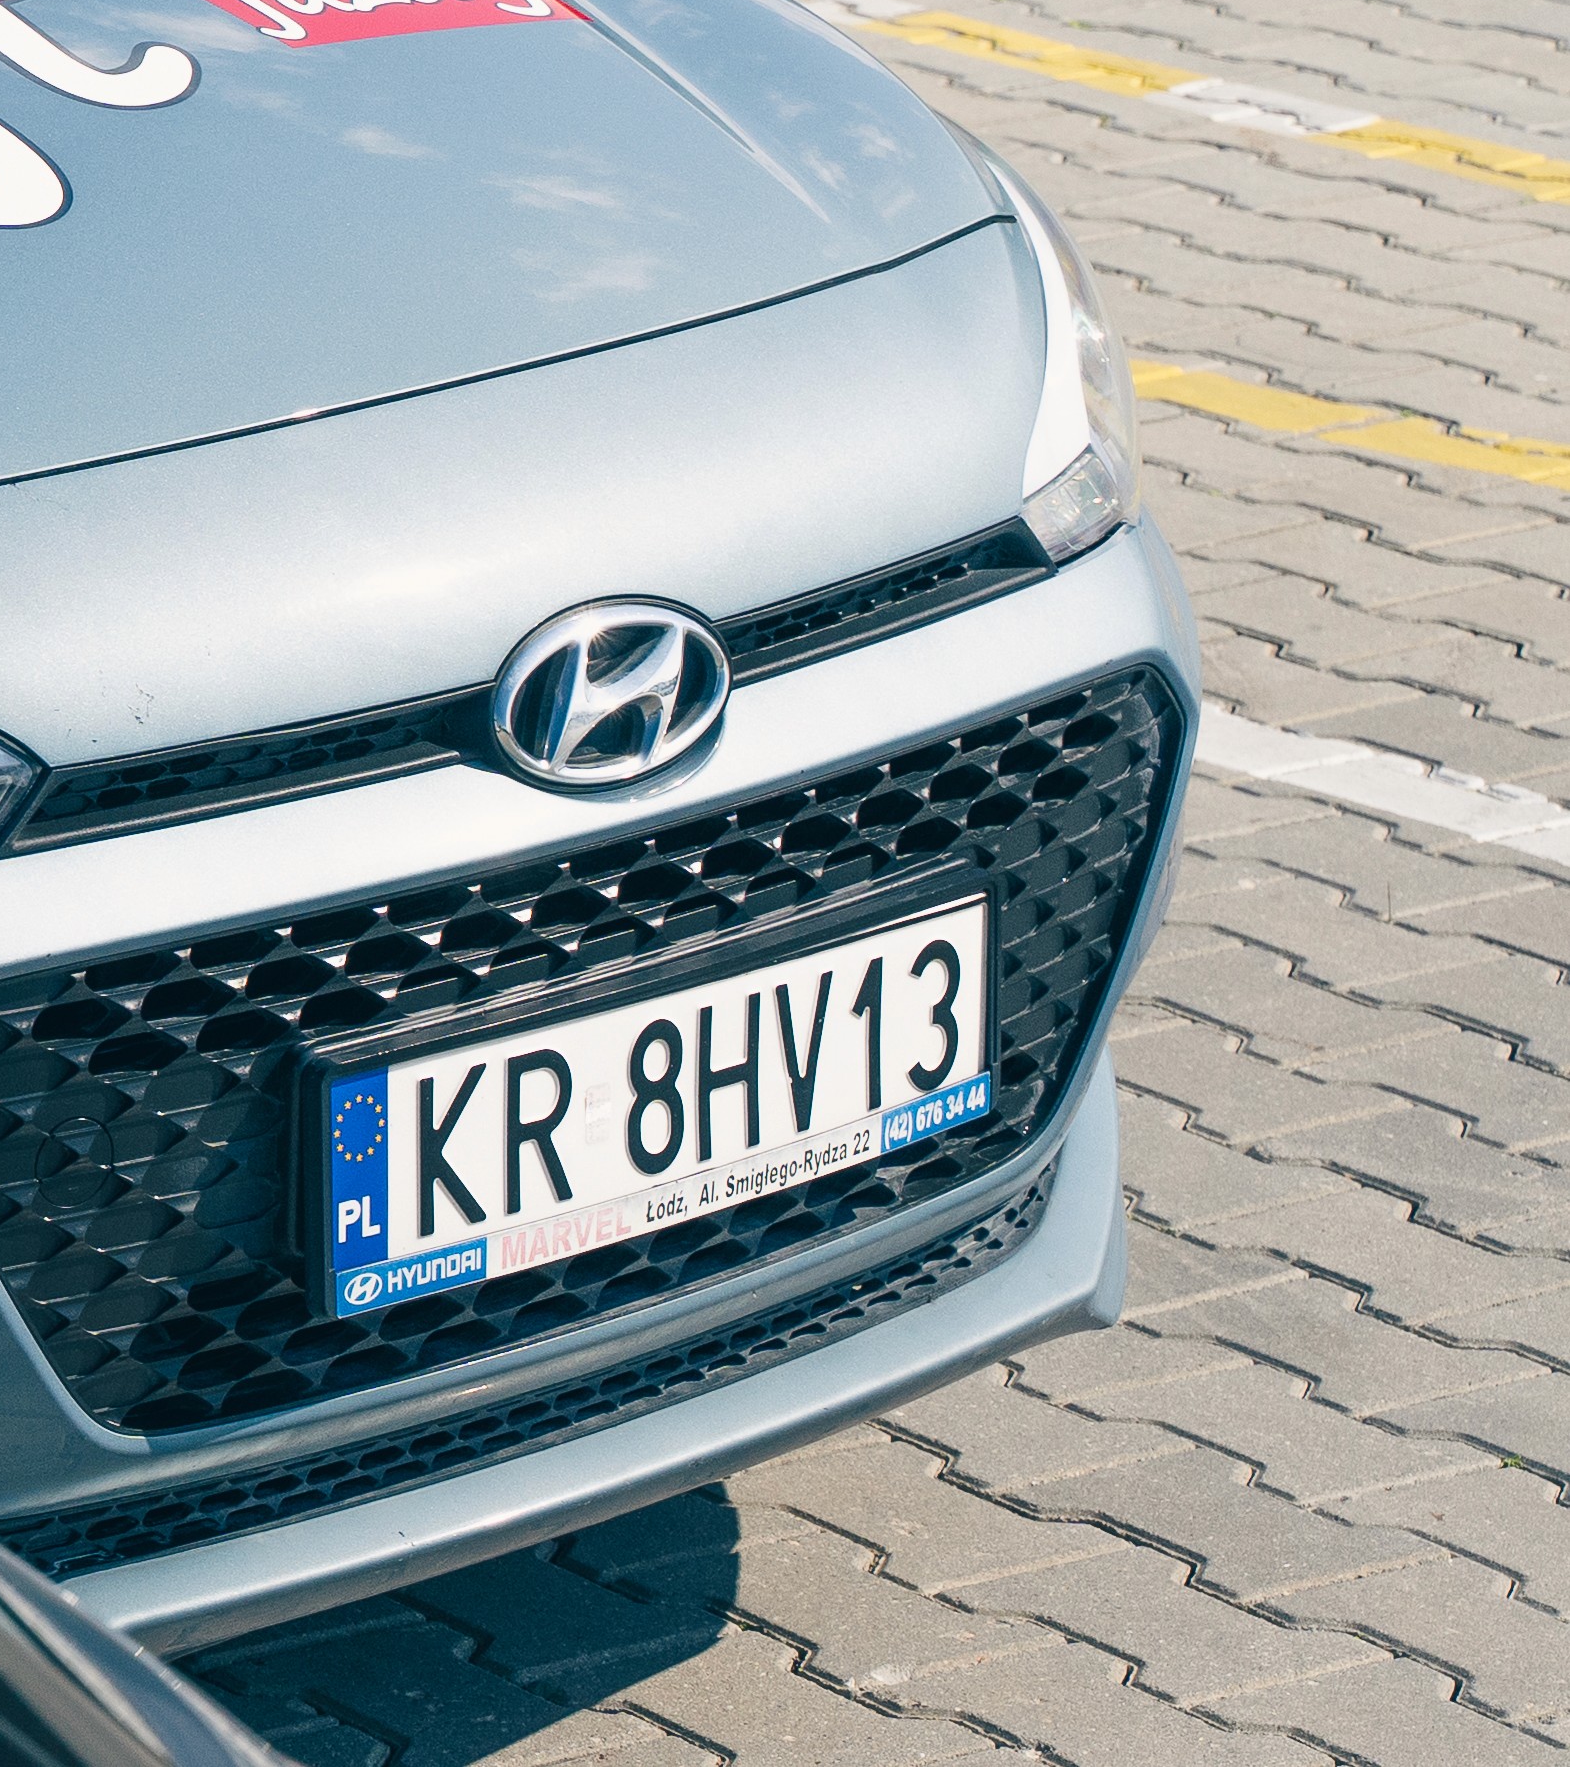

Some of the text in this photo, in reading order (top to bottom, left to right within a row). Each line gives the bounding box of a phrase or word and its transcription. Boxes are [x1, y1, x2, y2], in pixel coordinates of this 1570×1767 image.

[387, 1082, 986, 1294] HYUNDAI MARVEL Łódź, Al. Śmigłego-Rydza 22 (42) 676 34 44
[415, 939, 961, 1237] KR 8HV13
[338, 1195, 381, 1244] PL
